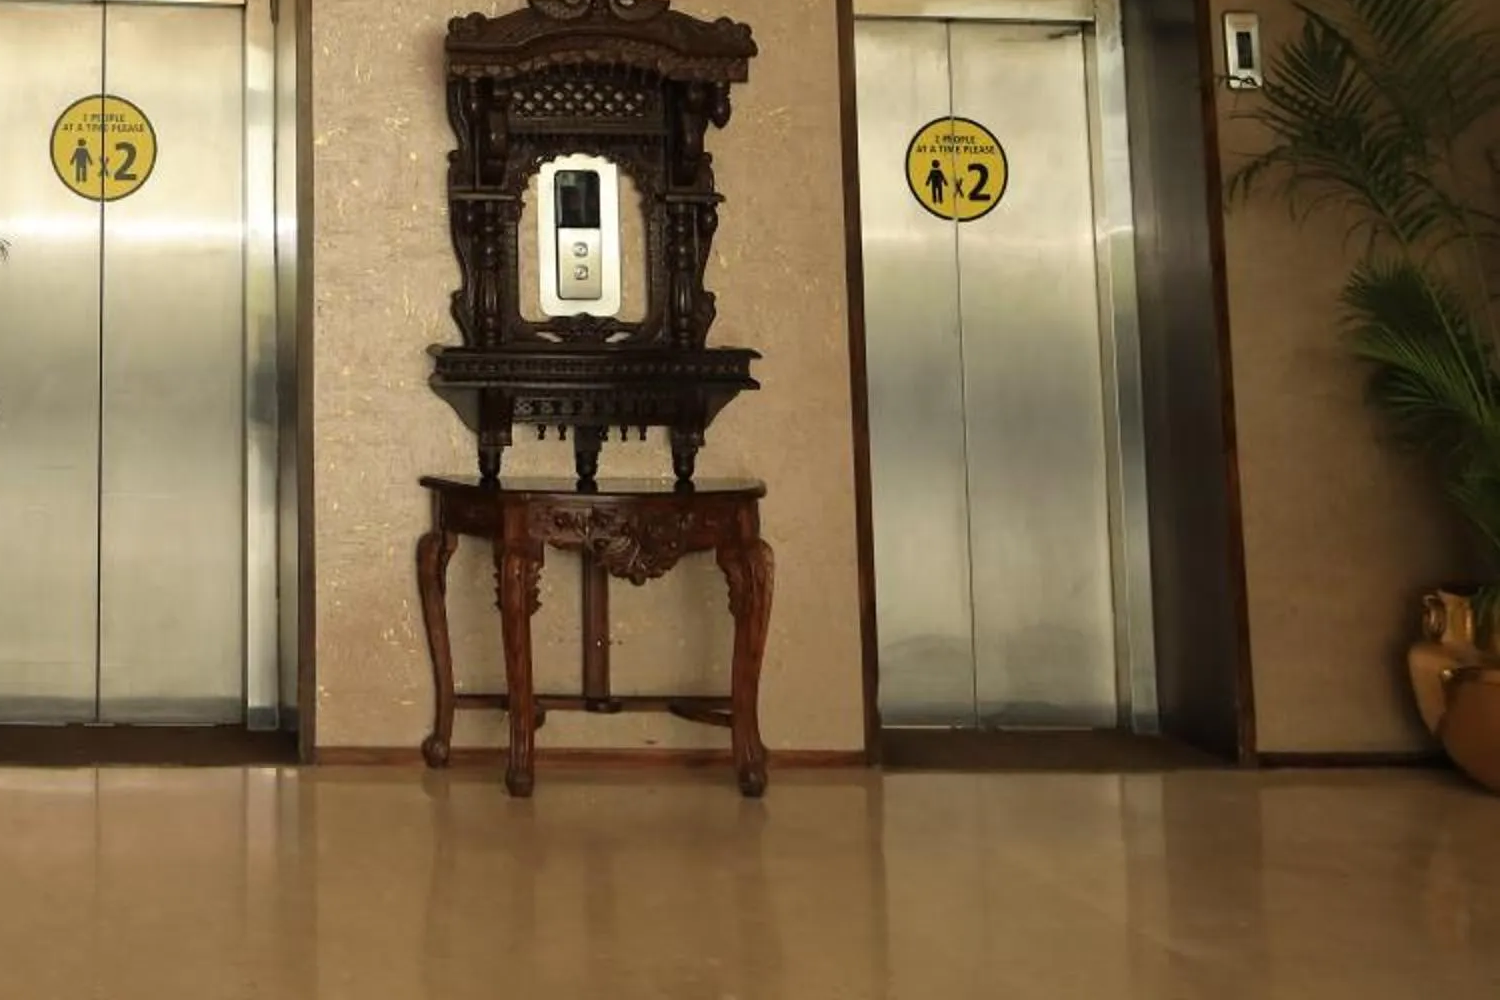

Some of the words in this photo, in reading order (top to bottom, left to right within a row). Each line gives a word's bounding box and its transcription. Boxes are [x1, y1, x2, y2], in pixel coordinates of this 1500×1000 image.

[76, 123, 83, 133] A
[111, 123, 145, 133] PLEASE
[942, 135, 976, 145] PEOPLE
[916, 144, 926, 153] AT
[929, 144, 937, 153] A
[938, 144, 961, 154] TIME
[963, 144, 995, 155] PLEASE
